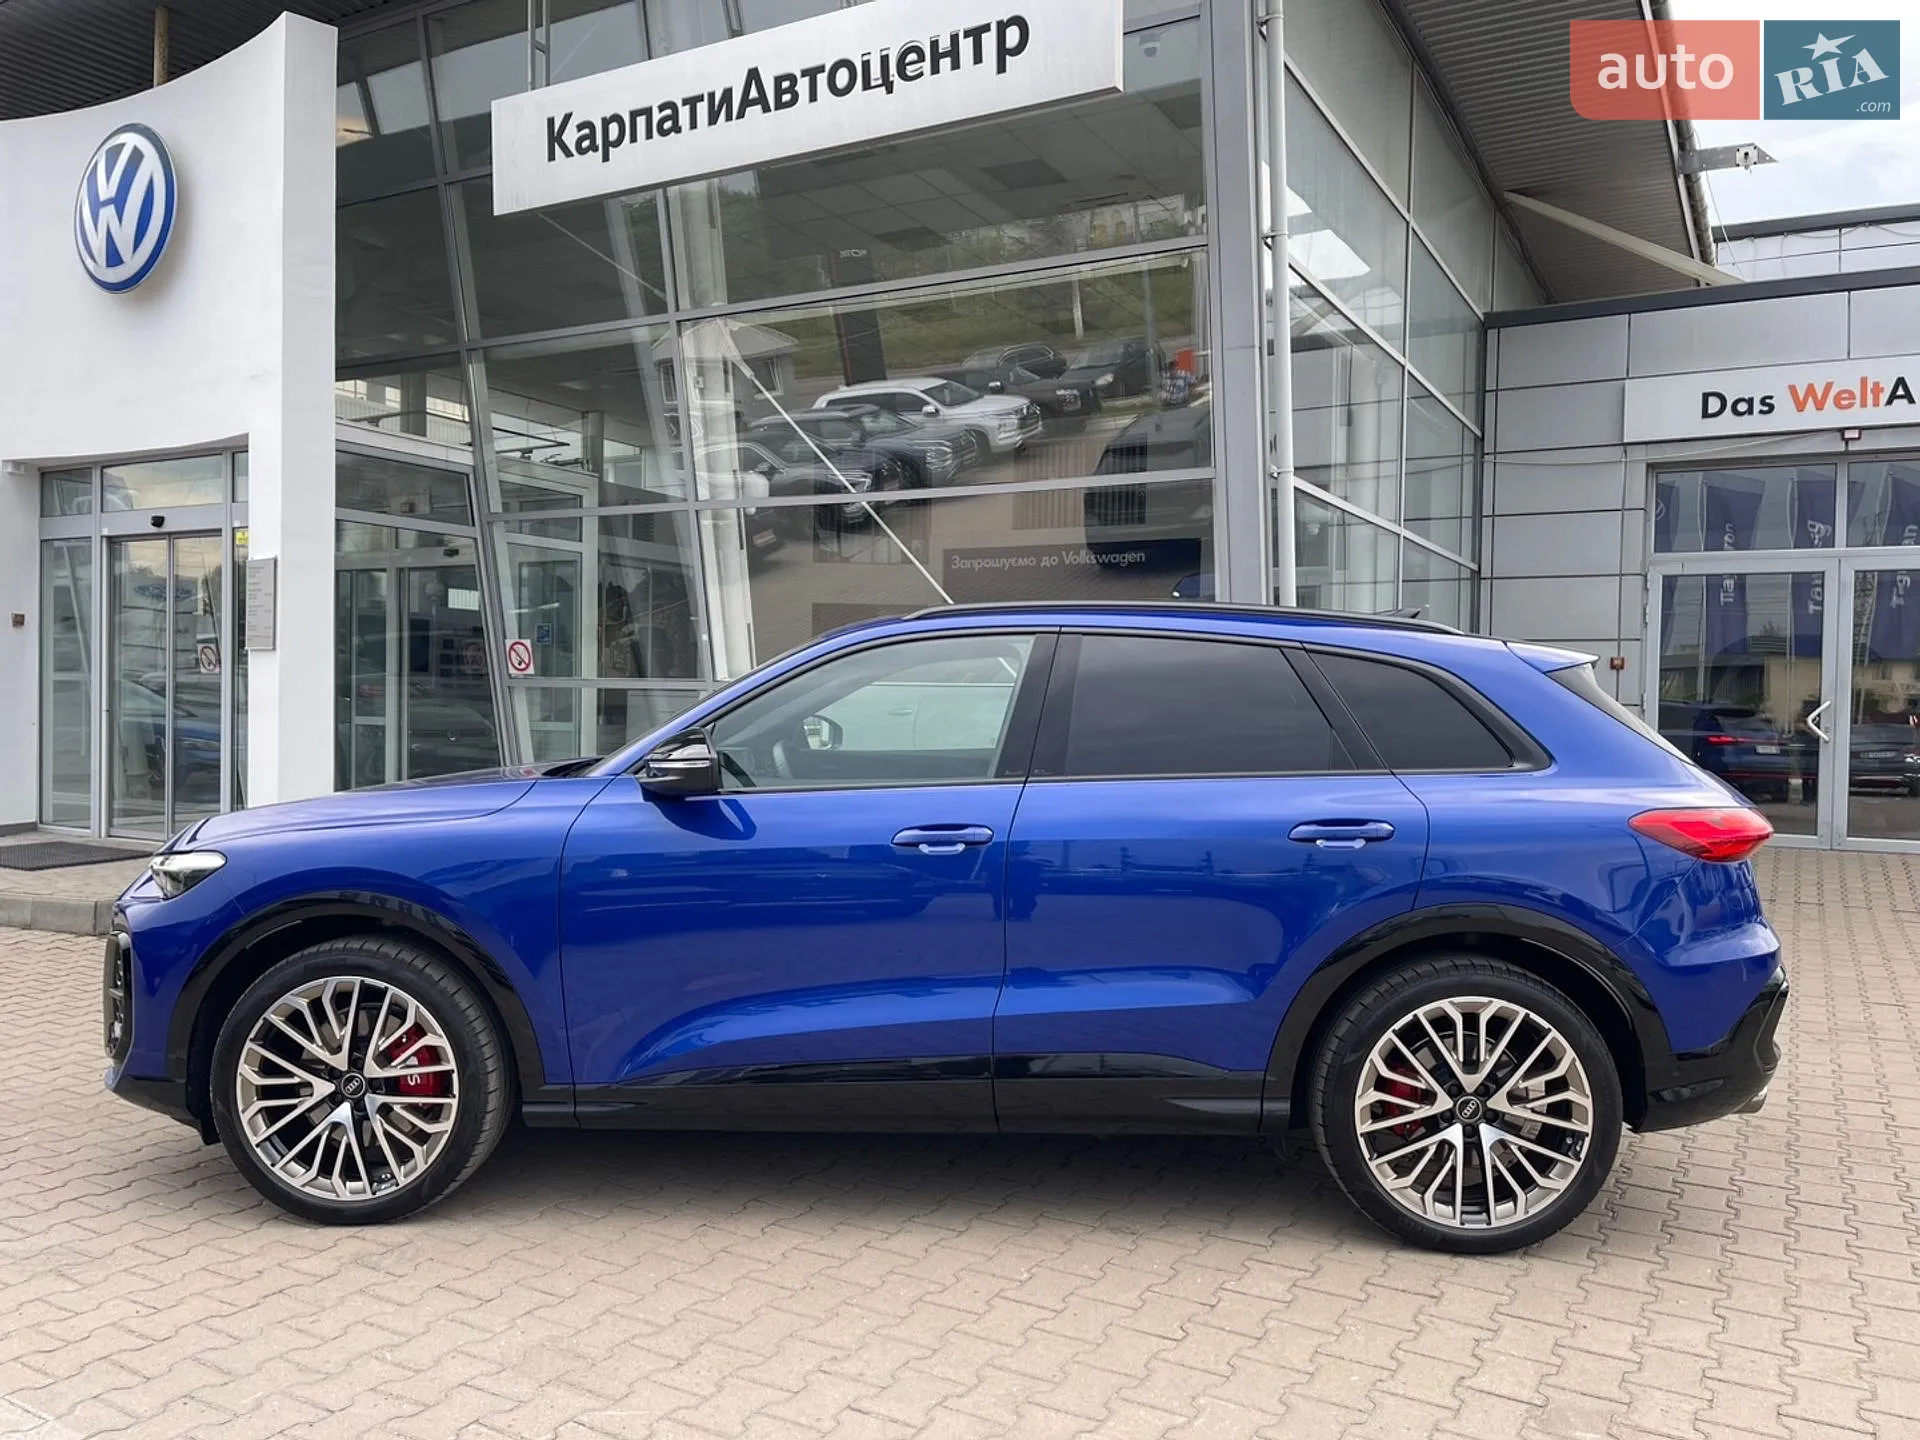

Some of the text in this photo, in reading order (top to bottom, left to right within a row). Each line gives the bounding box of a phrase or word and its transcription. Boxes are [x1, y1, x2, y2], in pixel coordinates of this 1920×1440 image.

[546, 14, 1030, 163] КарпатиАвтоцентр
[1701, 376, 1916, 419] Das WeltA
[952, 550, 1145, 571] Запрошуємо до Volkswagen
